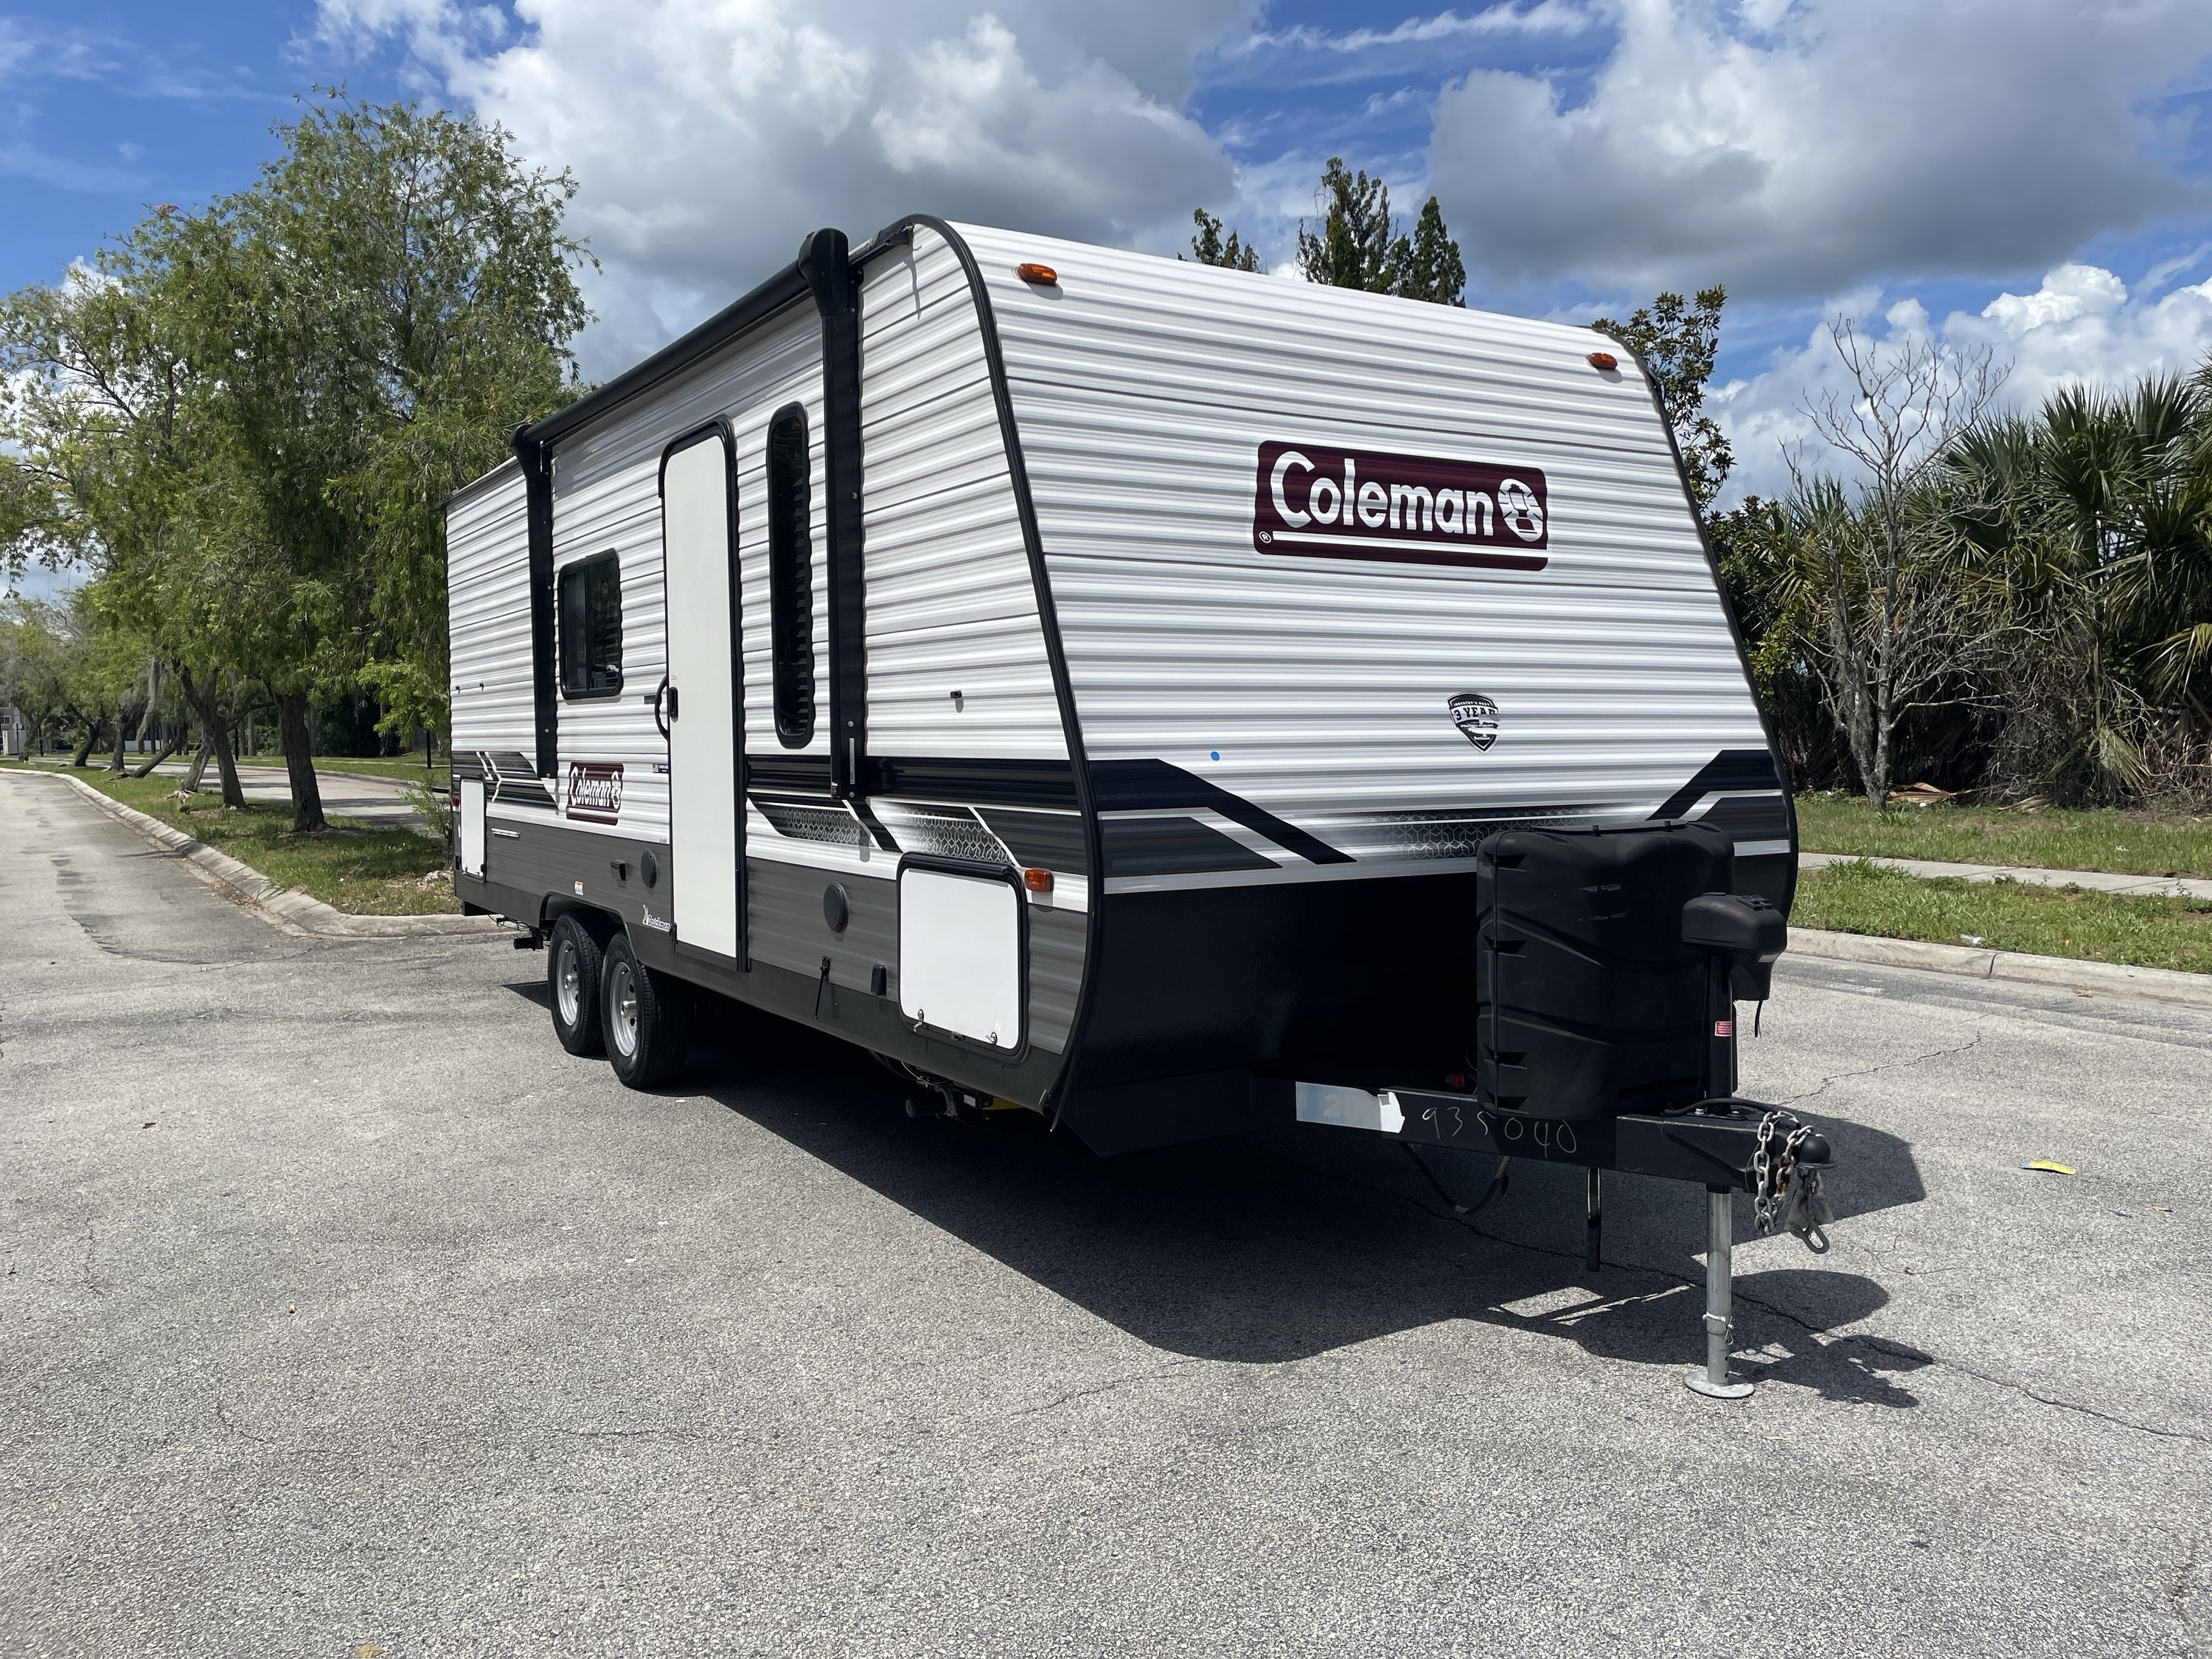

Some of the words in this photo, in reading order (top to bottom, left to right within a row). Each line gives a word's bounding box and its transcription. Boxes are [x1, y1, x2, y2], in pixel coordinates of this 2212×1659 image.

[1270, 451, 1495, 536] Coleman
[1453, 709, 1461, 720] 3
[569, 765, 611, 807] Coleman
[1422, 1107, 1577, 1159] 935040
